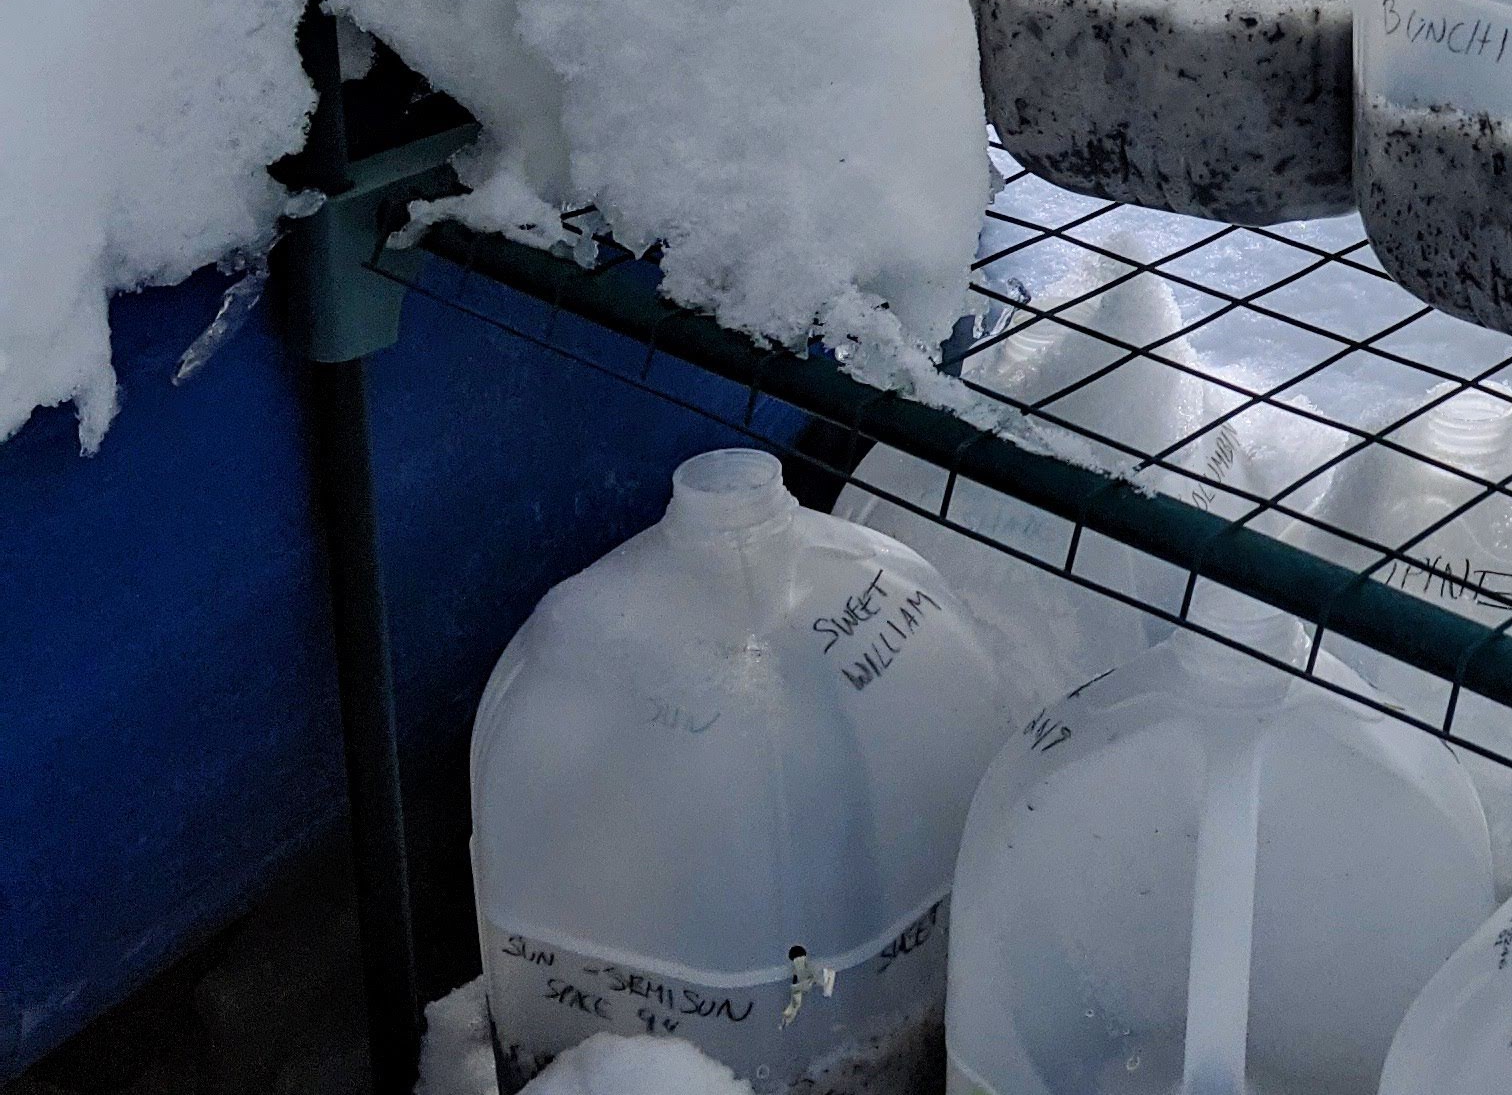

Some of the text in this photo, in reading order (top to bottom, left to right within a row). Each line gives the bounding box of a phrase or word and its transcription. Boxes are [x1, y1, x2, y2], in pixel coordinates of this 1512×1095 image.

[812, 568, 888, 655] SWEET
[841, 590, 942, 691] WILLIAM
[502, 934, 555, 966] SUN
[679, 988, 754, 1022] SUN
